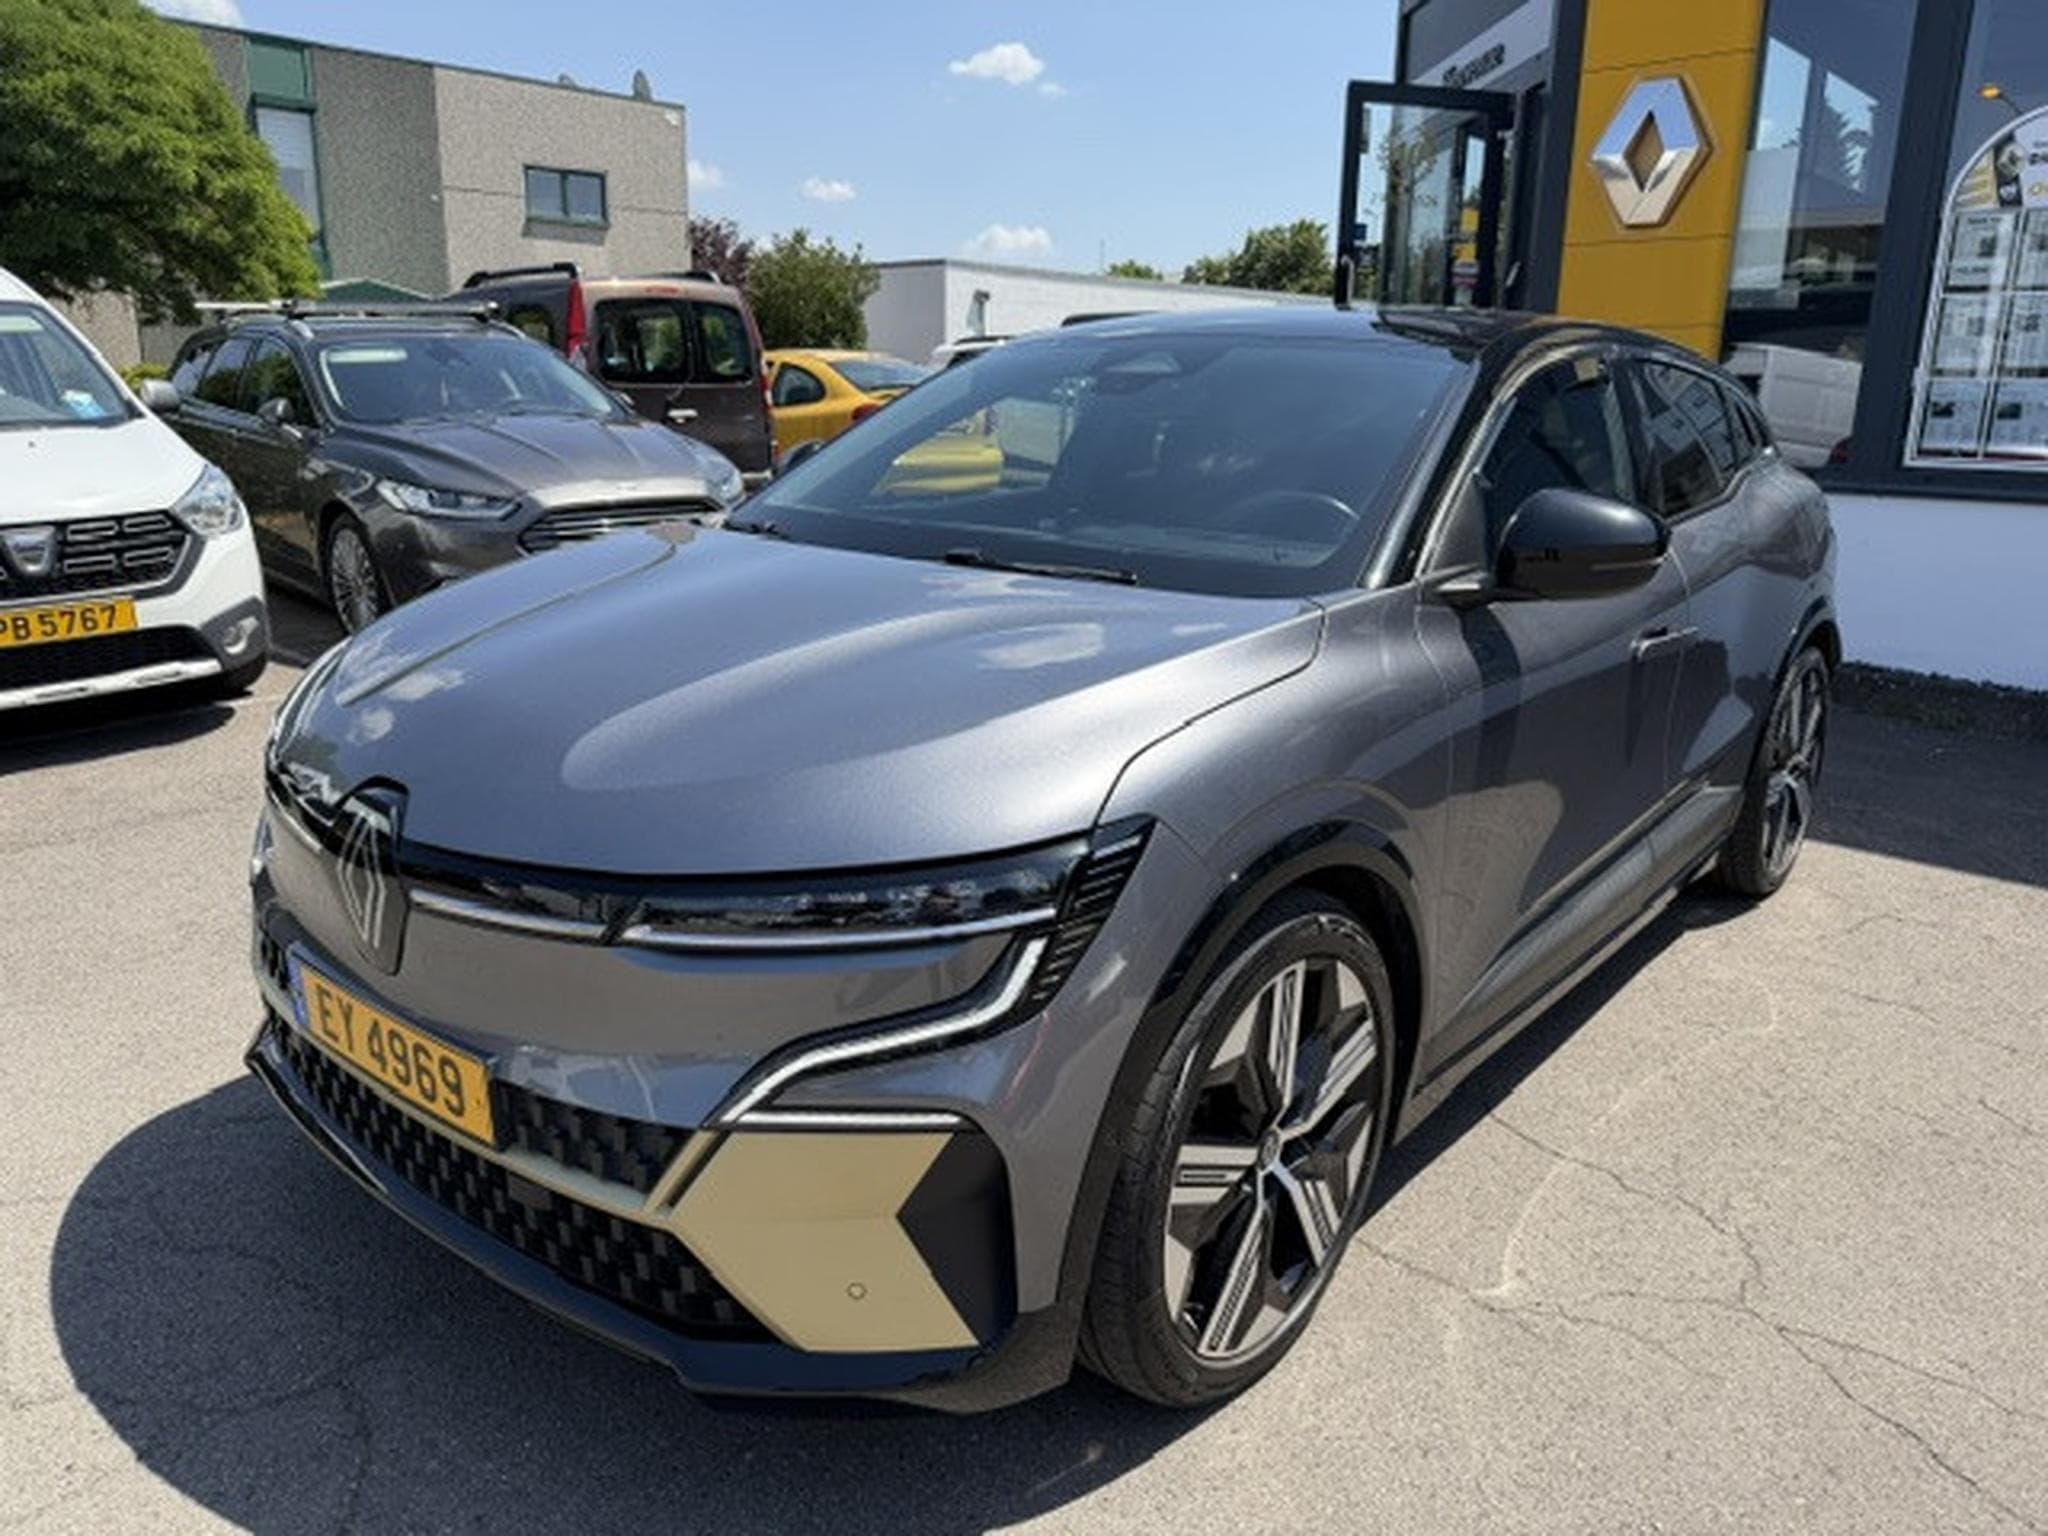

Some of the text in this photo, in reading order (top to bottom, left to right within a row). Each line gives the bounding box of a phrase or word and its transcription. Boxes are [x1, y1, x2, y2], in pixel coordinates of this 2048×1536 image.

[37, 604, 116, 637] 5767
[316, 983, 465, 1117] EY 4969
